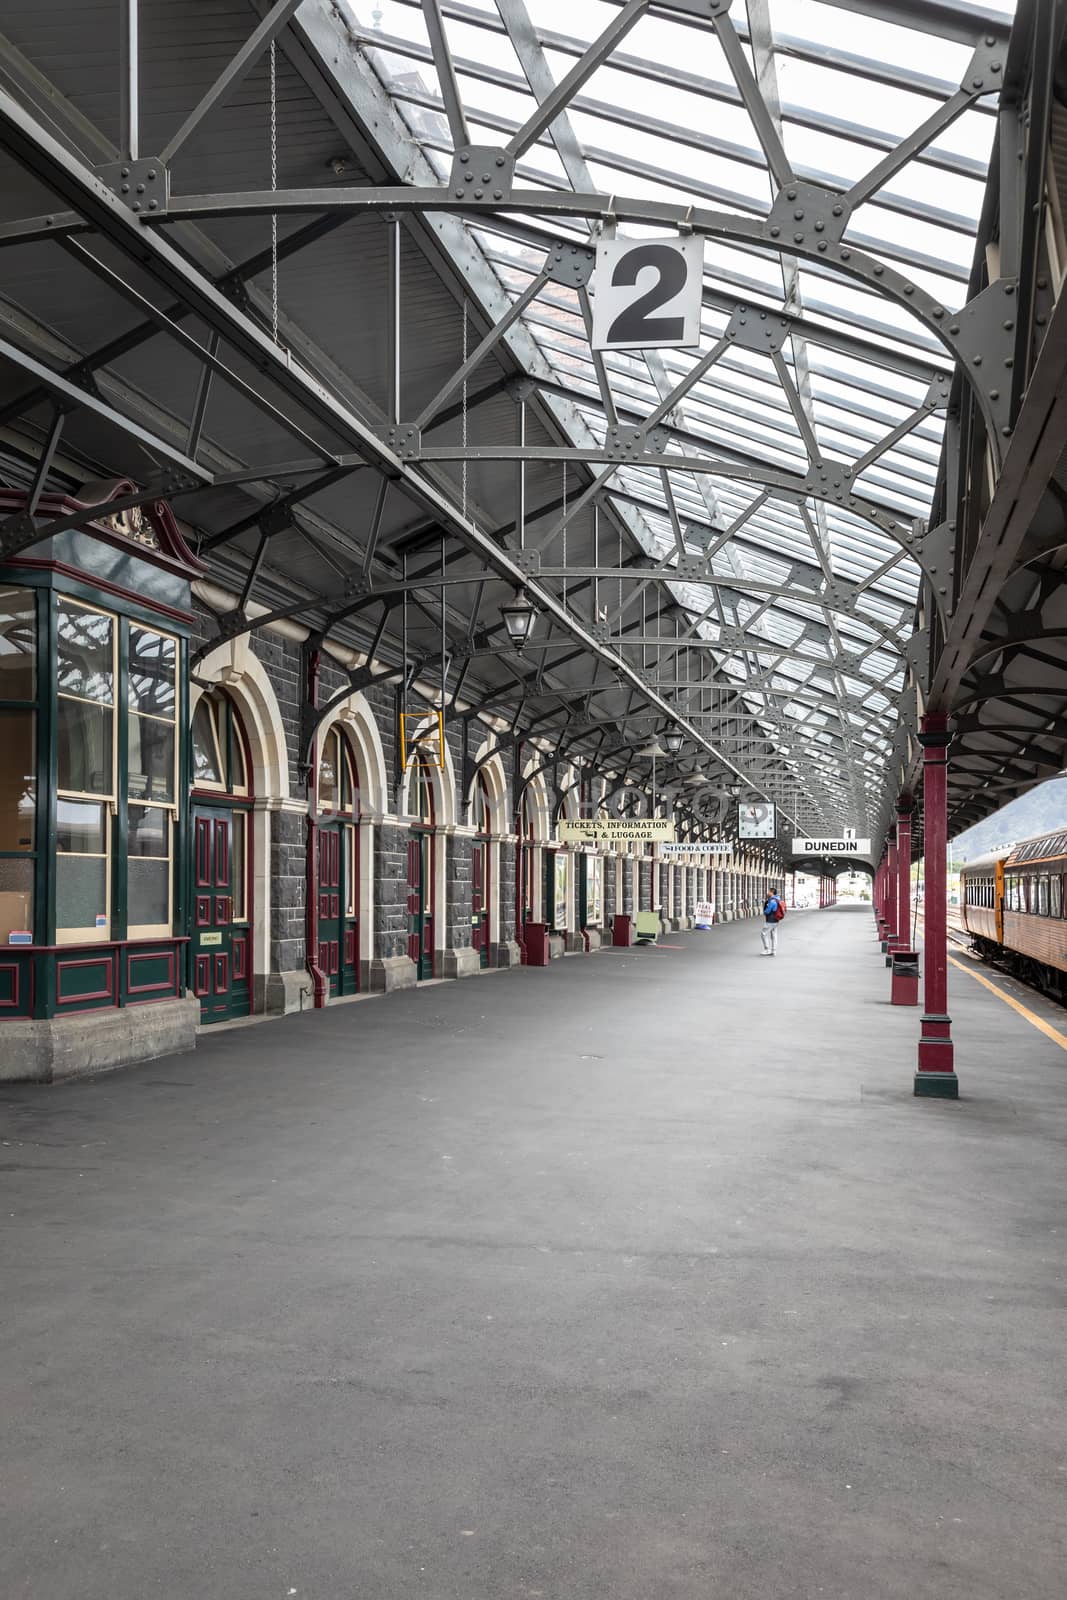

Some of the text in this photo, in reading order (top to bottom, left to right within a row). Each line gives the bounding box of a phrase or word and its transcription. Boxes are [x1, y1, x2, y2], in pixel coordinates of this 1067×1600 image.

[606, 244, 688, 343] 2
[566, 821, 668, 830] TICKETS, INFORMATION
[611, 831, 653, 839] LUGGAGE
[846, 829, 852, 839] 1
[804, 841, 858, 851] DUNEDIN
